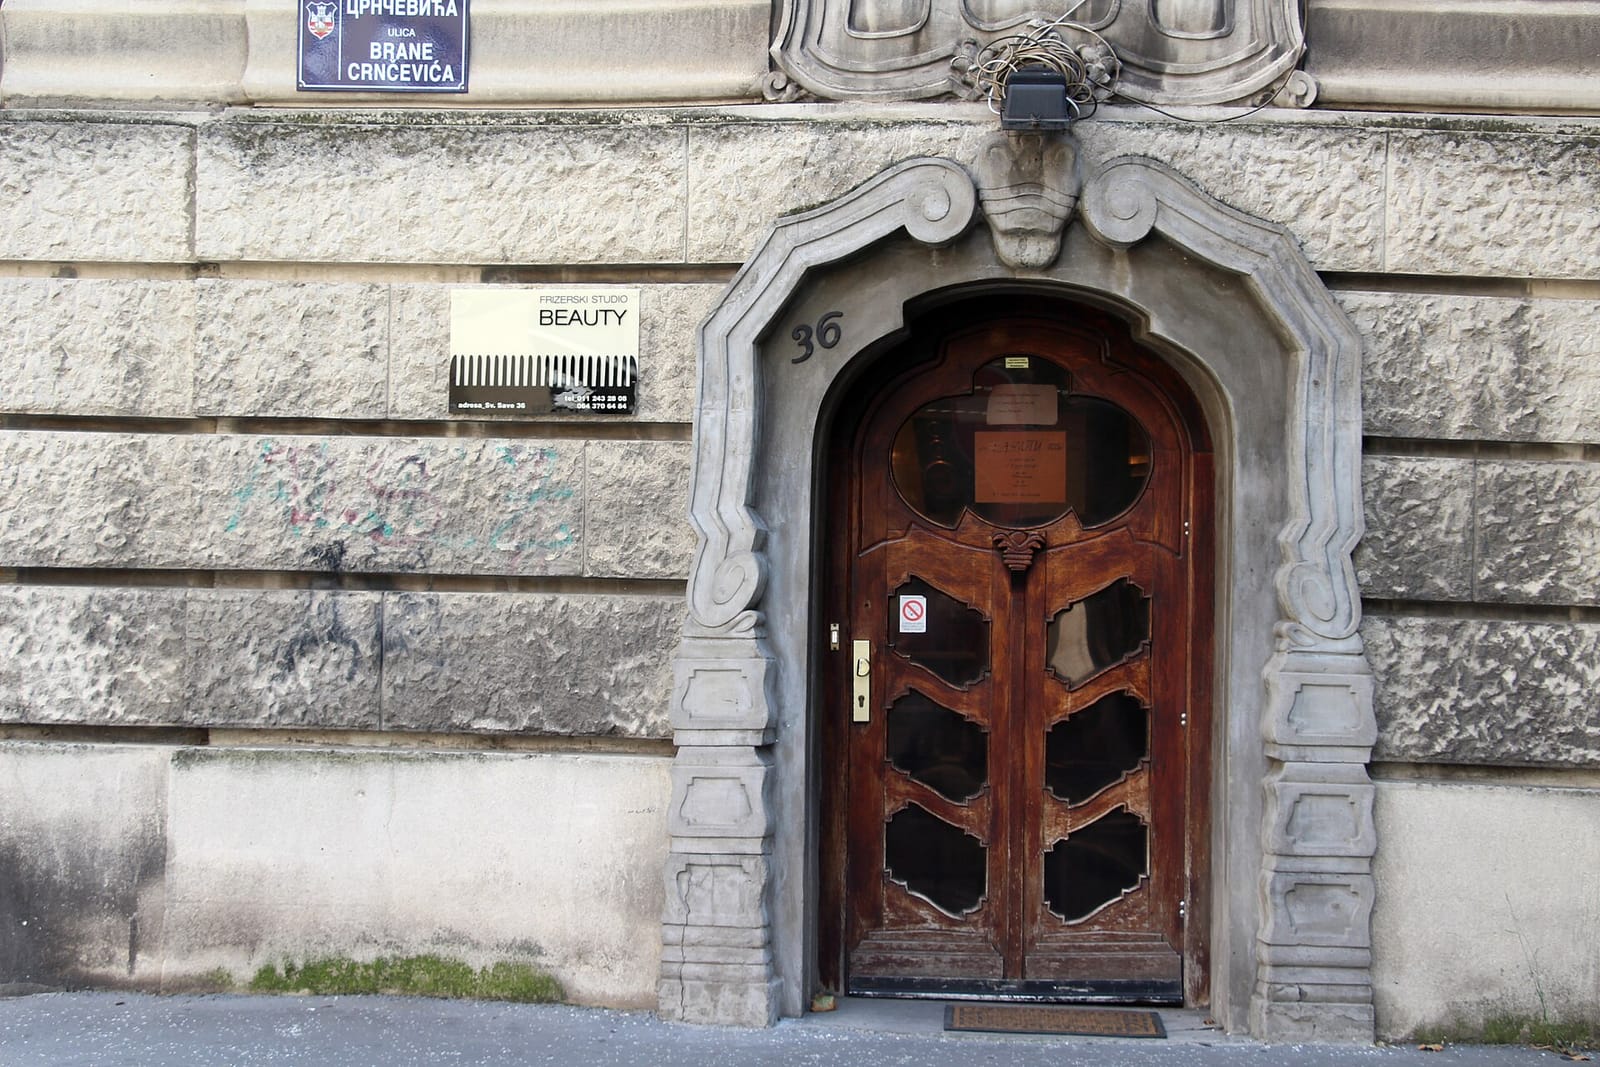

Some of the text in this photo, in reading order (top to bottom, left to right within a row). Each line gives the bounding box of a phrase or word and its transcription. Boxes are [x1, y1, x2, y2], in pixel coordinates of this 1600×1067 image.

[346, 0, 458, 19] ЦРНЧЕВИЋА
[387, 28, 416, 37] ULICA
[370, 42, 433, 61] BRANE
[347, 59, 455, 83] CRNČEVIĆA
[539, 295, 628, 304] FRIZERSKI STUDIO
[539, 309, 628, 326] BEAUTY
[791, 311, 844, 365] 36
[591, 402, 606, 410] 370
